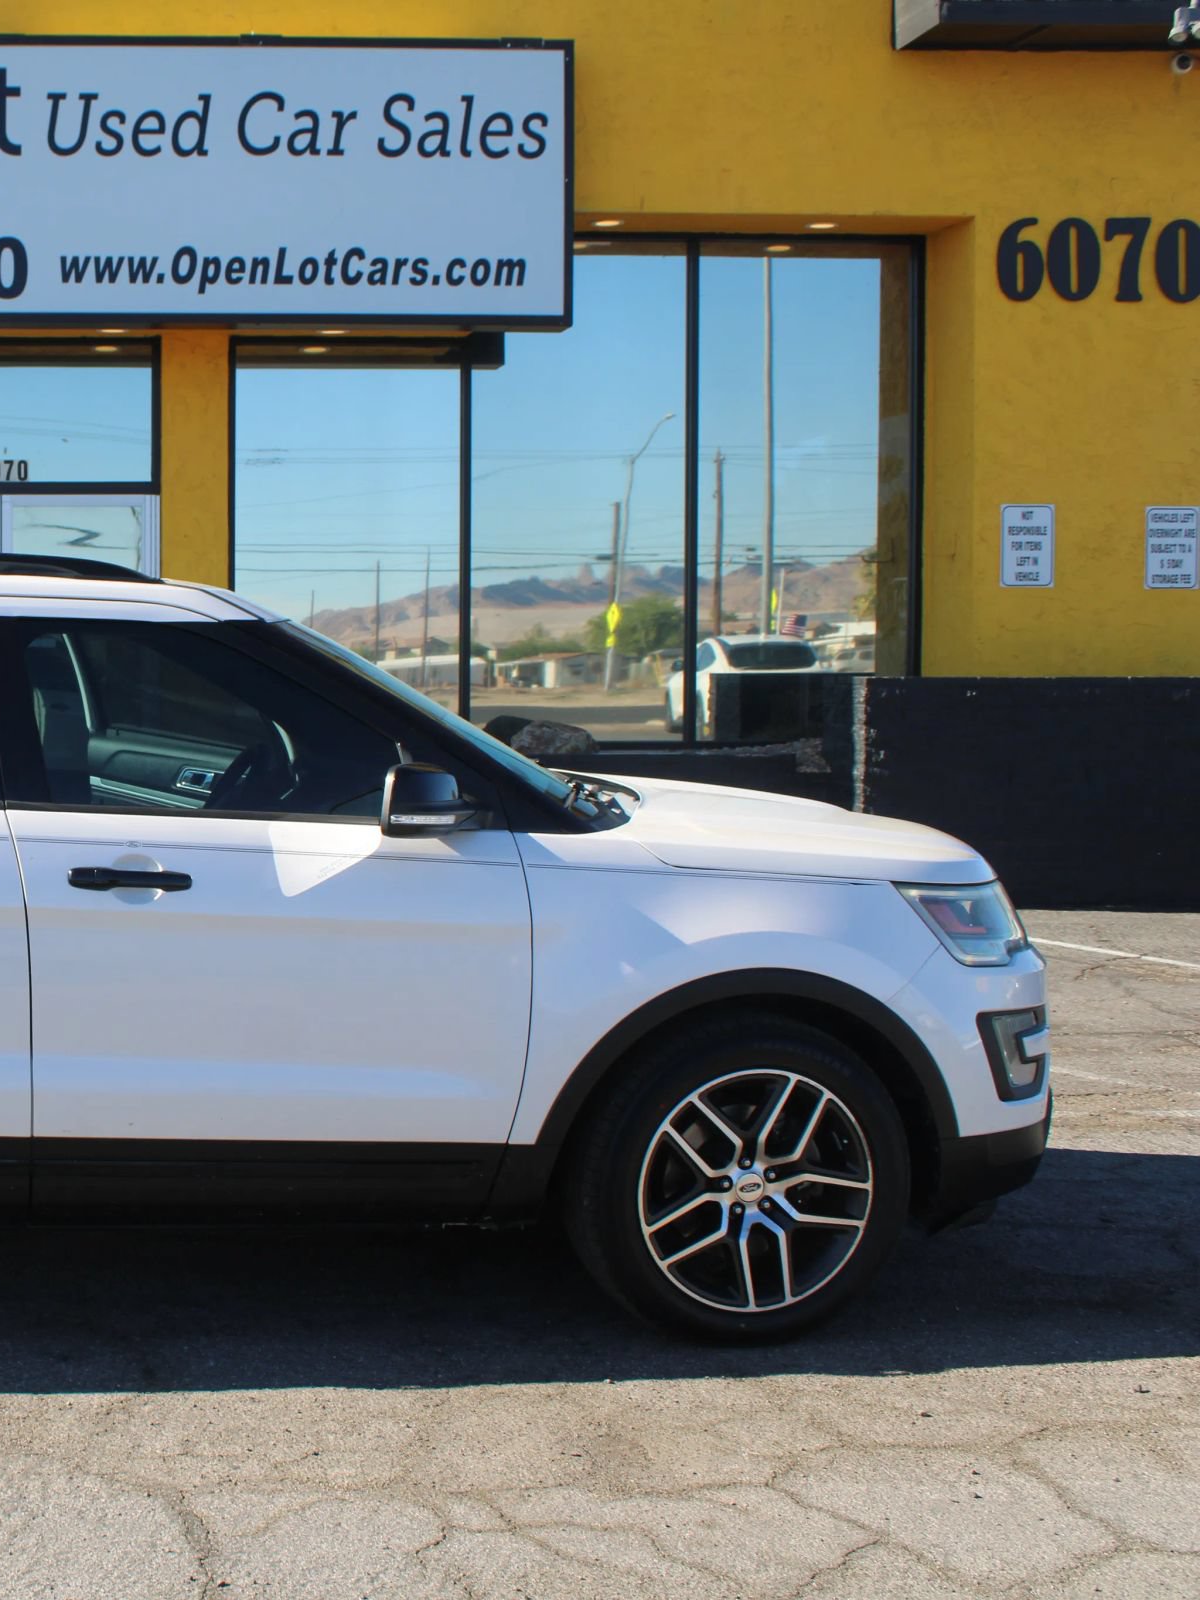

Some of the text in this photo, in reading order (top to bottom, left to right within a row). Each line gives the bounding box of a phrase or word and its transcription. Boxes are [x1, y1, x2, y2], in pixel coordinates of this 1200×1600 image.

[46, 92, 212, 158] Used
[237, 91, 358, 157] Car
[378, 92, 549, 160] Sales
[996, 216, 1200, 304] 6070
[60, 245, 527, 295] www.OpenLotCars.com
[1021, 510, 1034, 521] NOT
[1150, 513, 1195, 524] VEHICLES LEFT
[1007, 525, 1048, 536] RESPONSIBLE
[1148, 528, 1196, 538] OVERNIGHT ARE
[1011, 541, 1042, 551] FOR ITEMS
[1150, 543, 1177, 554] SUBJECT
[1178, 543, 1187, 554] TO
[1016, 556, 1039, 567] LEFT IN
[1014, 571, 1040, 582] VEHICLE
[1151, 573, 1192, 584] STORAGE FEE
